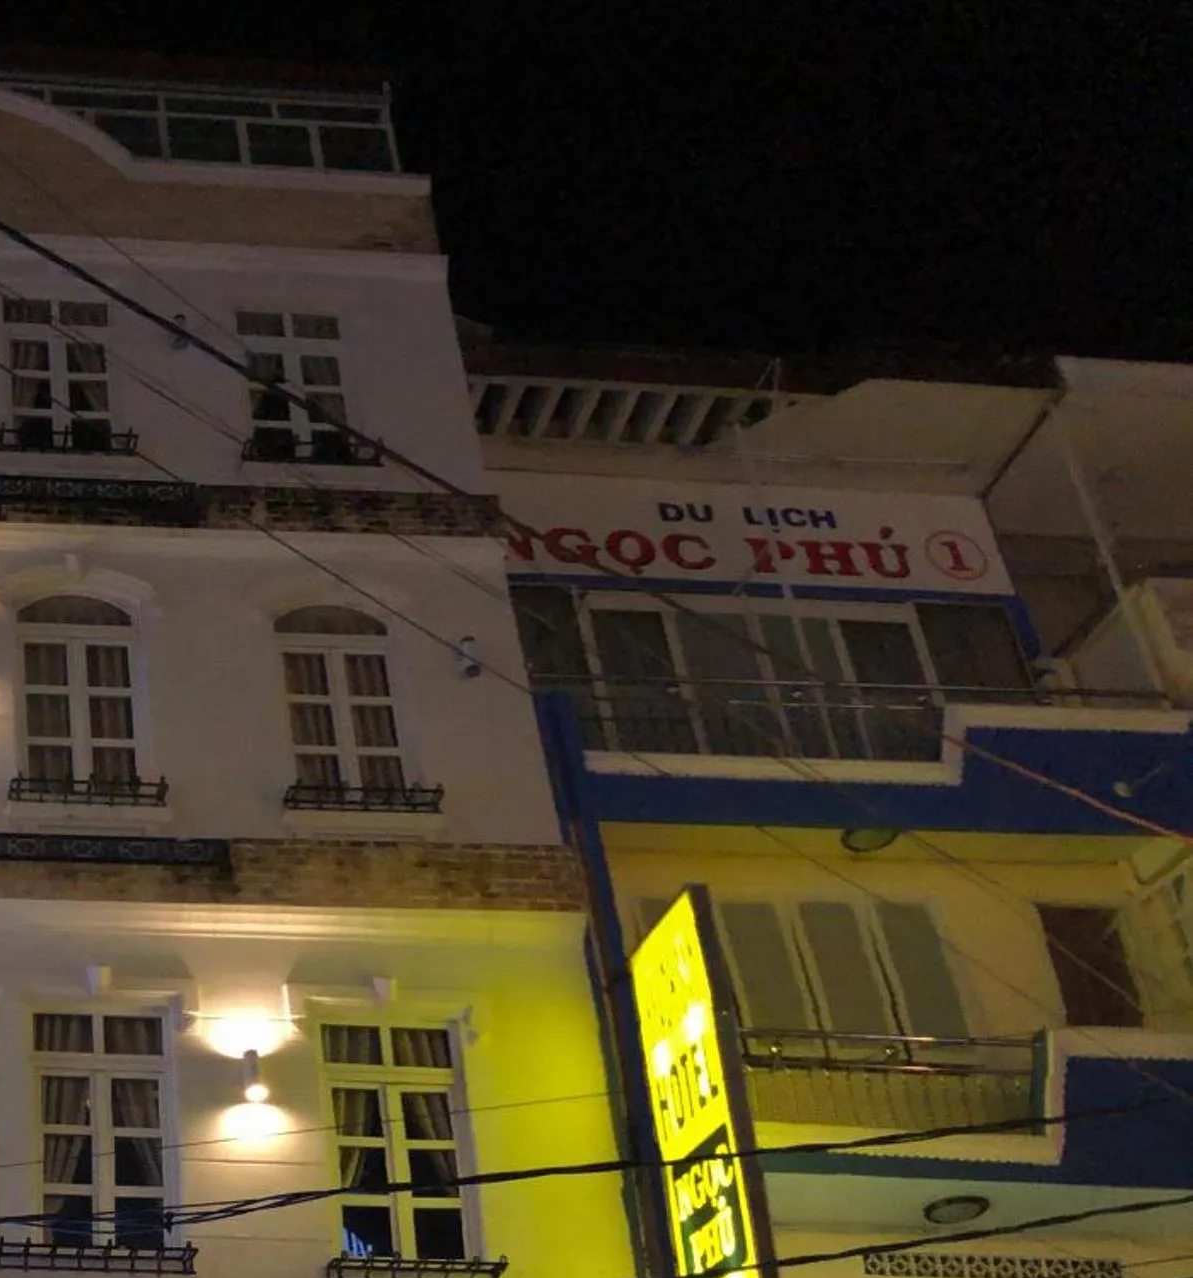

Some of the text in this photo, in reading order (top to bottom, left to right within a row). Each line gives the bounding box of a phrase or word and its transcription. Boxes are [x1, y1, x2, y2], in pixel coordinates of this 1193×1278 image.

[659, 502, 837, 533] DU LỊCH
[743, 525, 910, 579] PHÚ
[939, 539, 975, 572] 1
